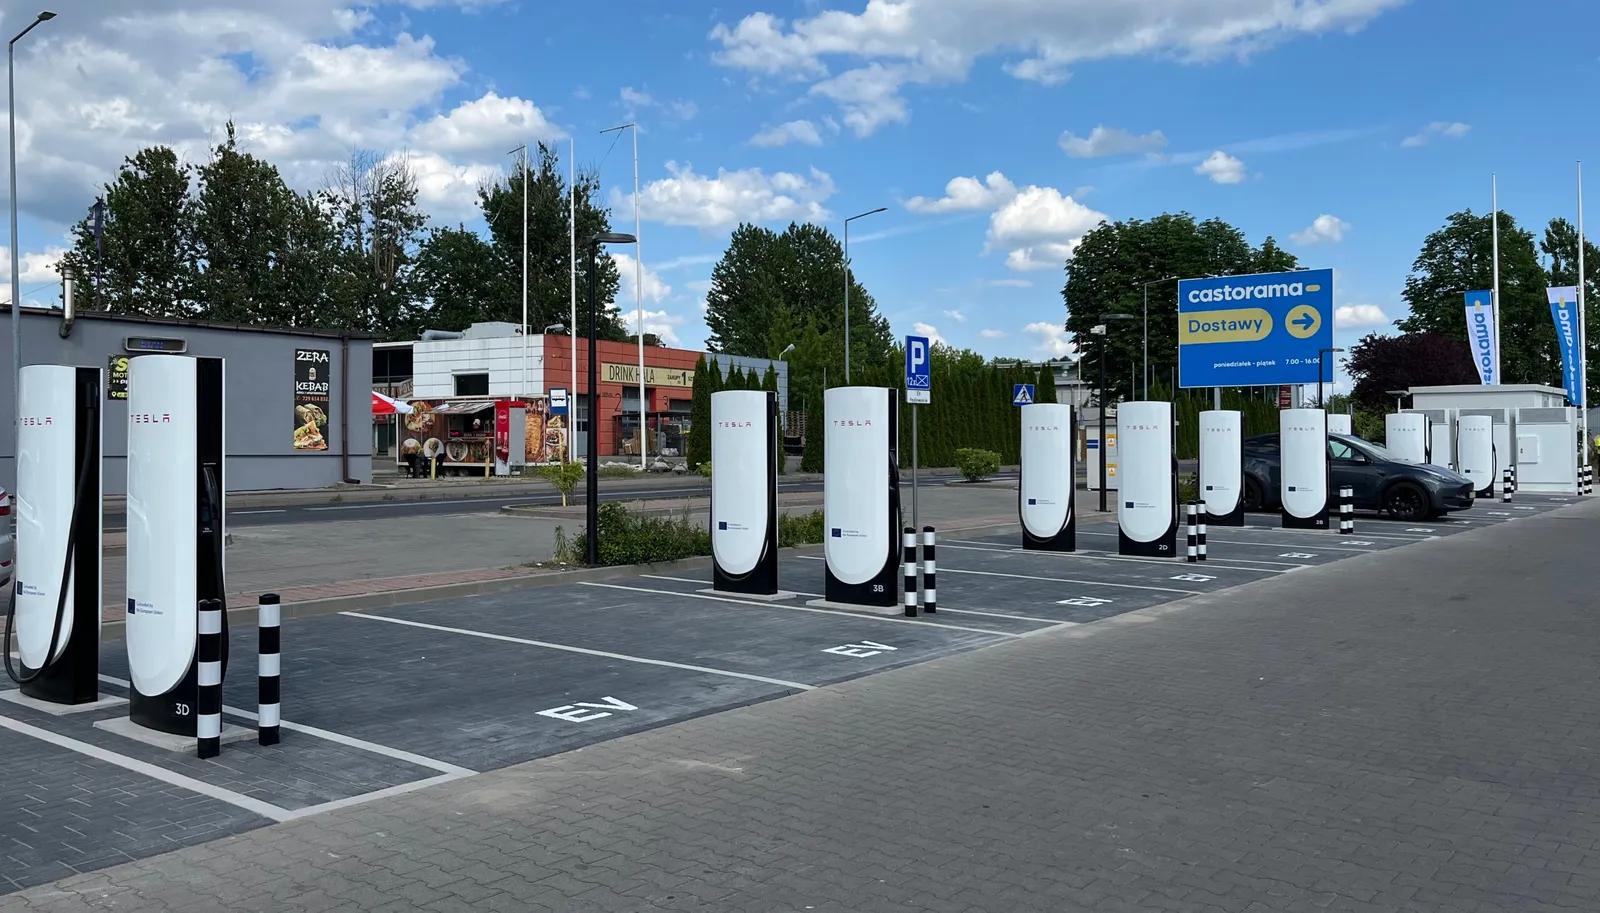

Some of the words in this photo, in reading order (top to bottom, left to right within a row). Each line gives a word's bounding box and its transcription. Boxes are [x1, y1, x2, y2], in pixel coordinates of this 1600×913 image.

[1188, 282, 1303, 303] castorama
[1188, 319, 1263, 333] Dostawy
[296, 350, 329, 363] ZERA
[911, 340, 925, 374] P
[1213, 361, 1252, 369] poniedziałek
[1256, 359, 1276, 368] piątek
[609, 365, 634, 382] DRINK
[681, 371, 686, 385] 1
[296, 381, 329, 391] KEBAB
[662, 395, 668, 411] 3
[131, 413, 170, 423] TESLA
[872, 584, 884, 593] 3B
[1057, 595, 1114, 608] EV
[821, 639, 898, 659] EV
[175, 702, 190, 716] 3D
[534, 695, 639, 724] EV
